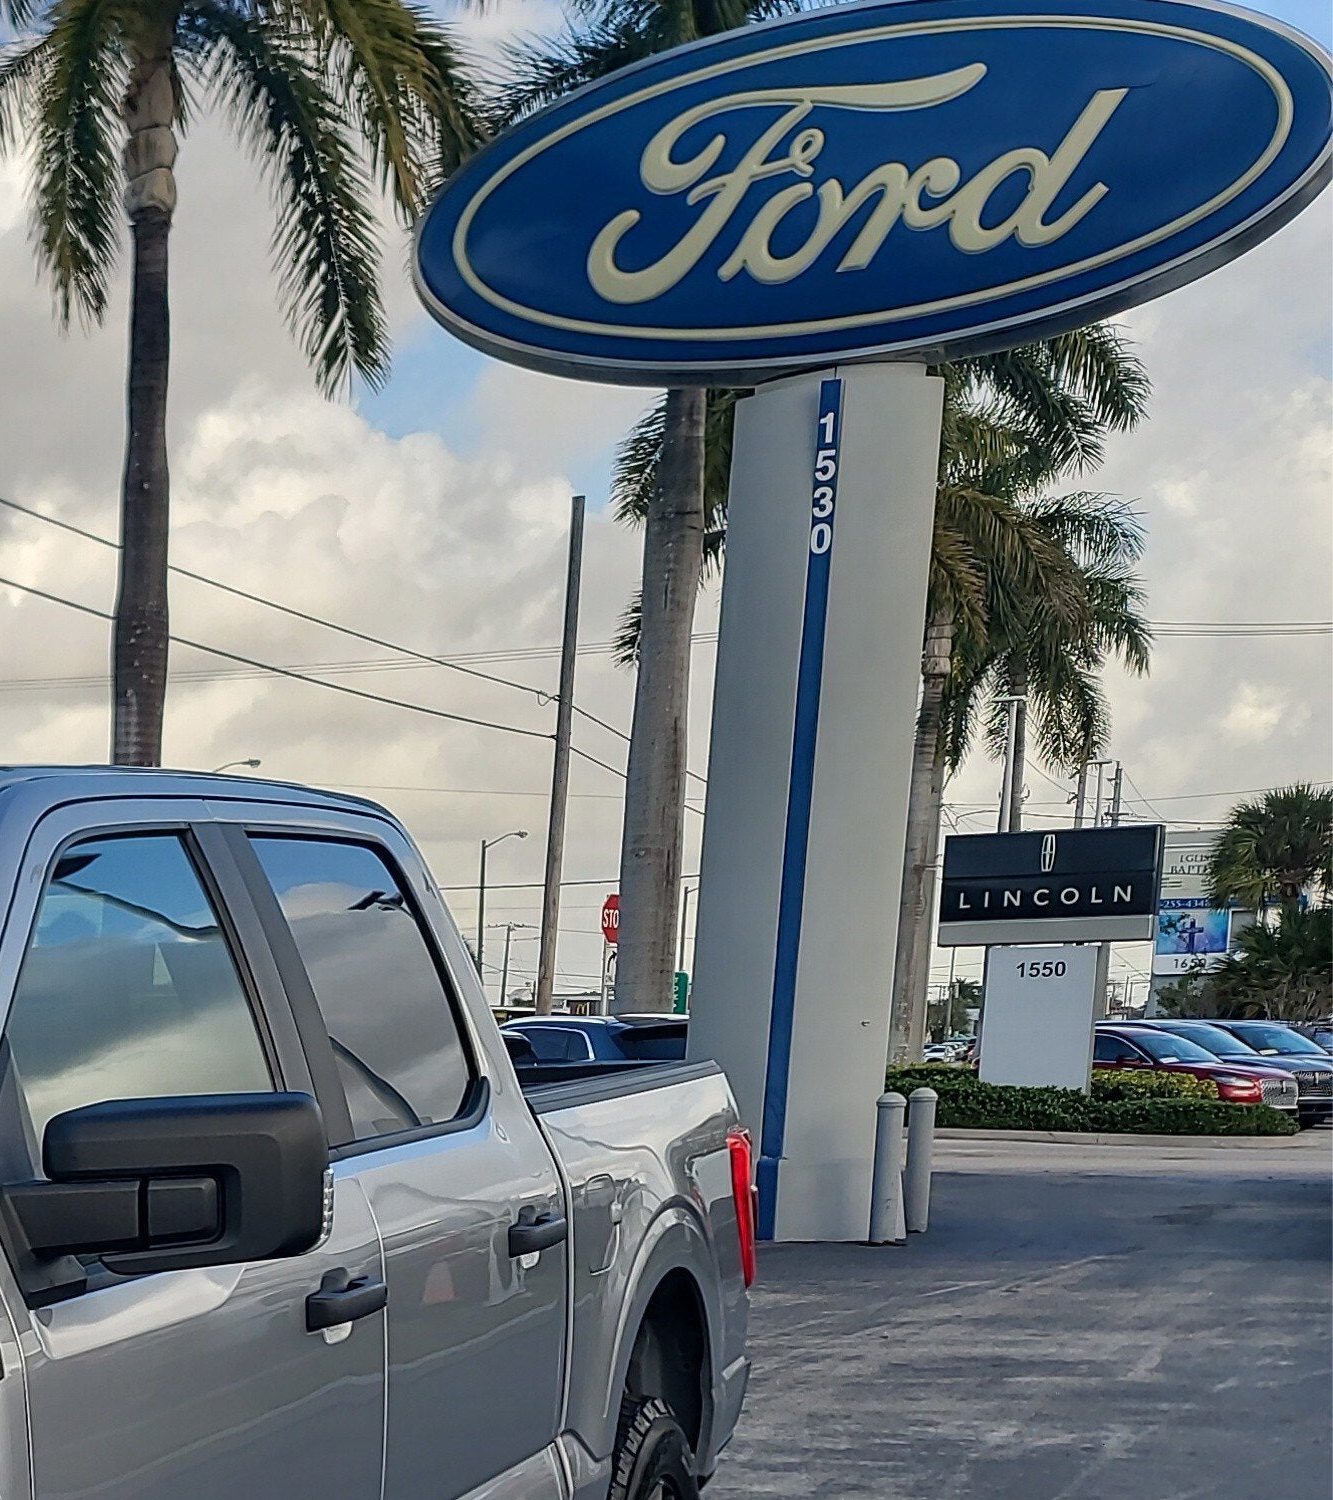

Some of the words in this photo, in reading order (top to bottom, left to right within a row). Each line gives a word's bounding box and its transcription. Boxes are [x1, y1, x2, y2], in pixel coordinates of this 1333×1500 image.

[587, 62, 1131, 304] Ford
[810, 412, 836, 555] 1530
[1179, 853, 1213, 863] EGLIS
[958, 885, 1132, 909] LINCOLN
[602, 909, 620, 929] STO
[1016, 961, 1066, 978] 1550
